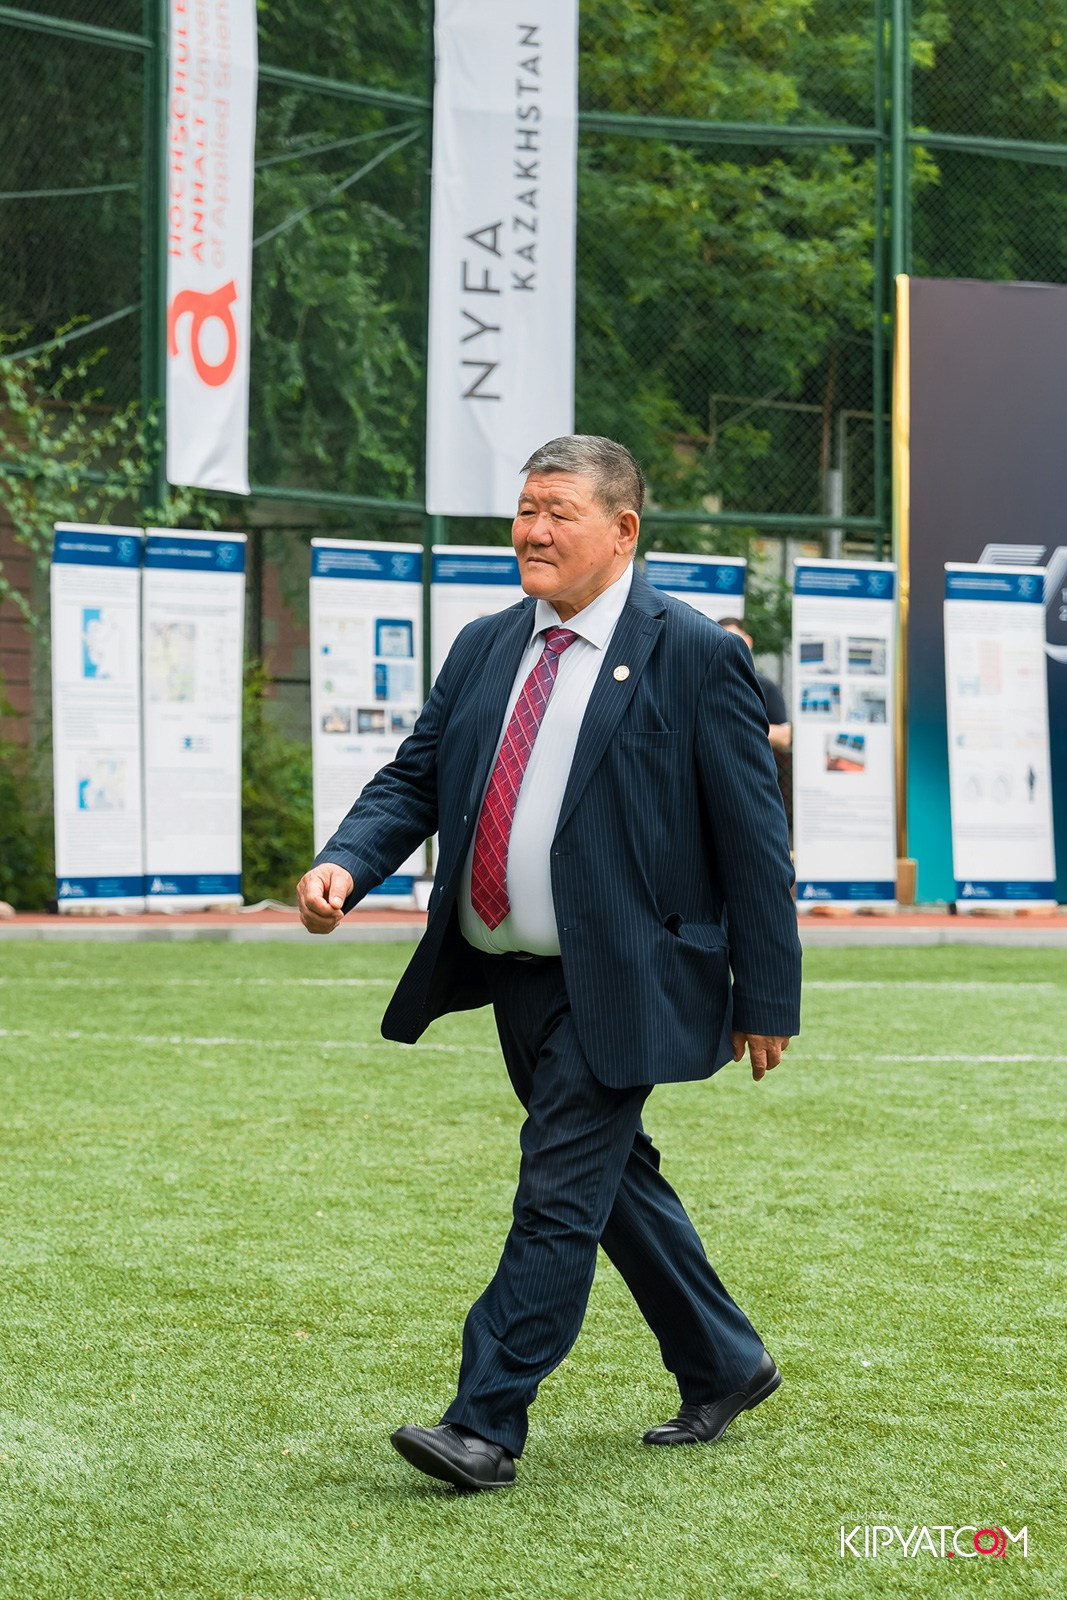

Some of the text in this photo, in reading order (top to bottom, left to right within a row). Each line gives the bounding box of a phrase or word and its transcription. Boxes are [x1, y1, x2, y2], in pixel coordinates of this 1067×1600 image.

[168, 0, 188, 257] HOCHSCHULE
[190, 113, 206, 266] ANHALT
[211, 99, 230, 229] Applied
[511, 23, 543, 291] KAZAKHSTAN
[211, 234, 226, 268] of
[461, 220, 504, 400] NYFA
